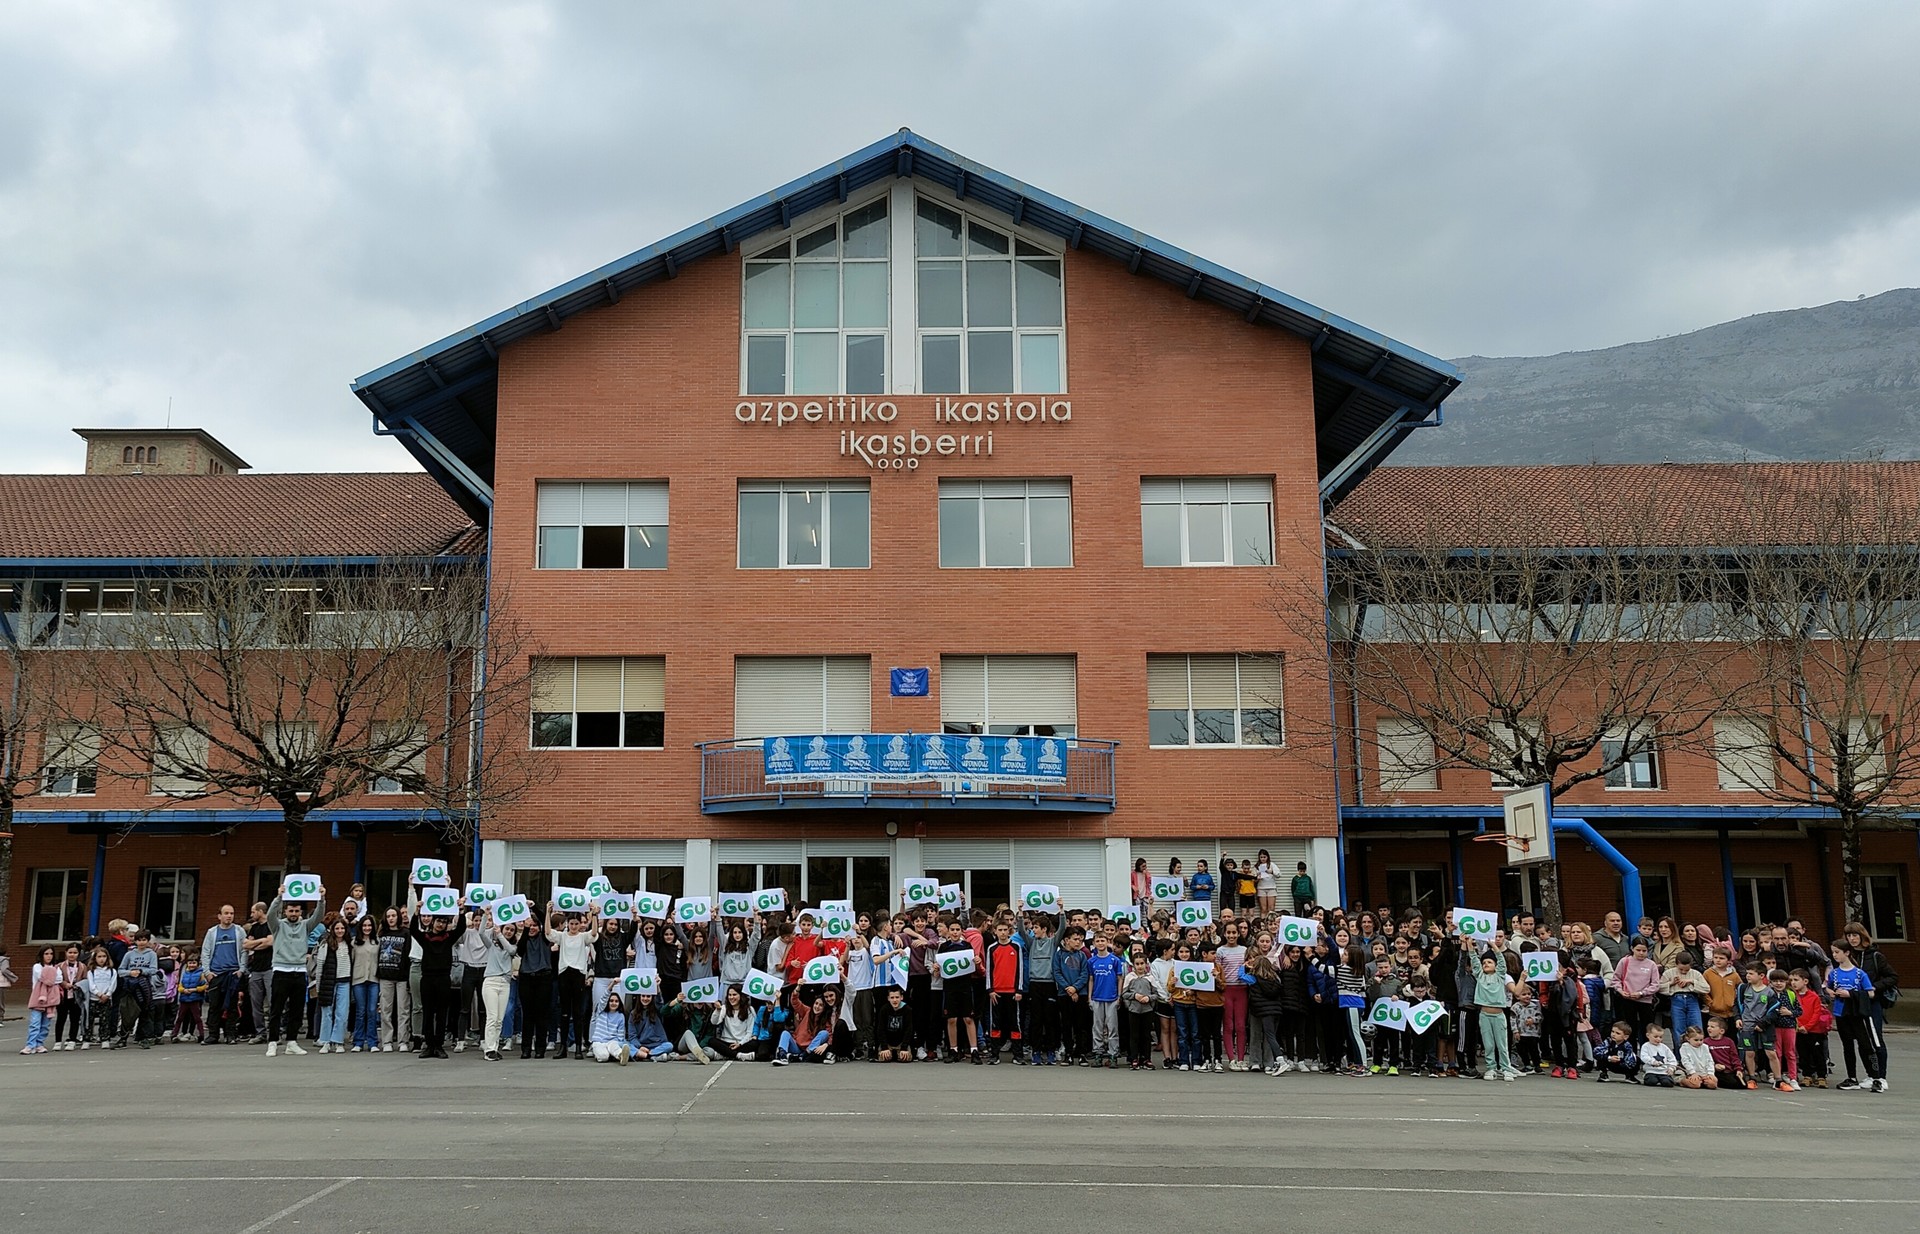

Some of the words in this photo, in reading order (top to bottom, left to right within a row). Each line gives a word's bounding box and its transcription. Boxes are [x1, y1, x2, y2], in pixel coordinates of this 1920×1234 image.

[735, 397, 898, 426] azpeitiko
[936, 397, 1072, 422] ikastola
[840, 429, 992, 468] ikasberri
